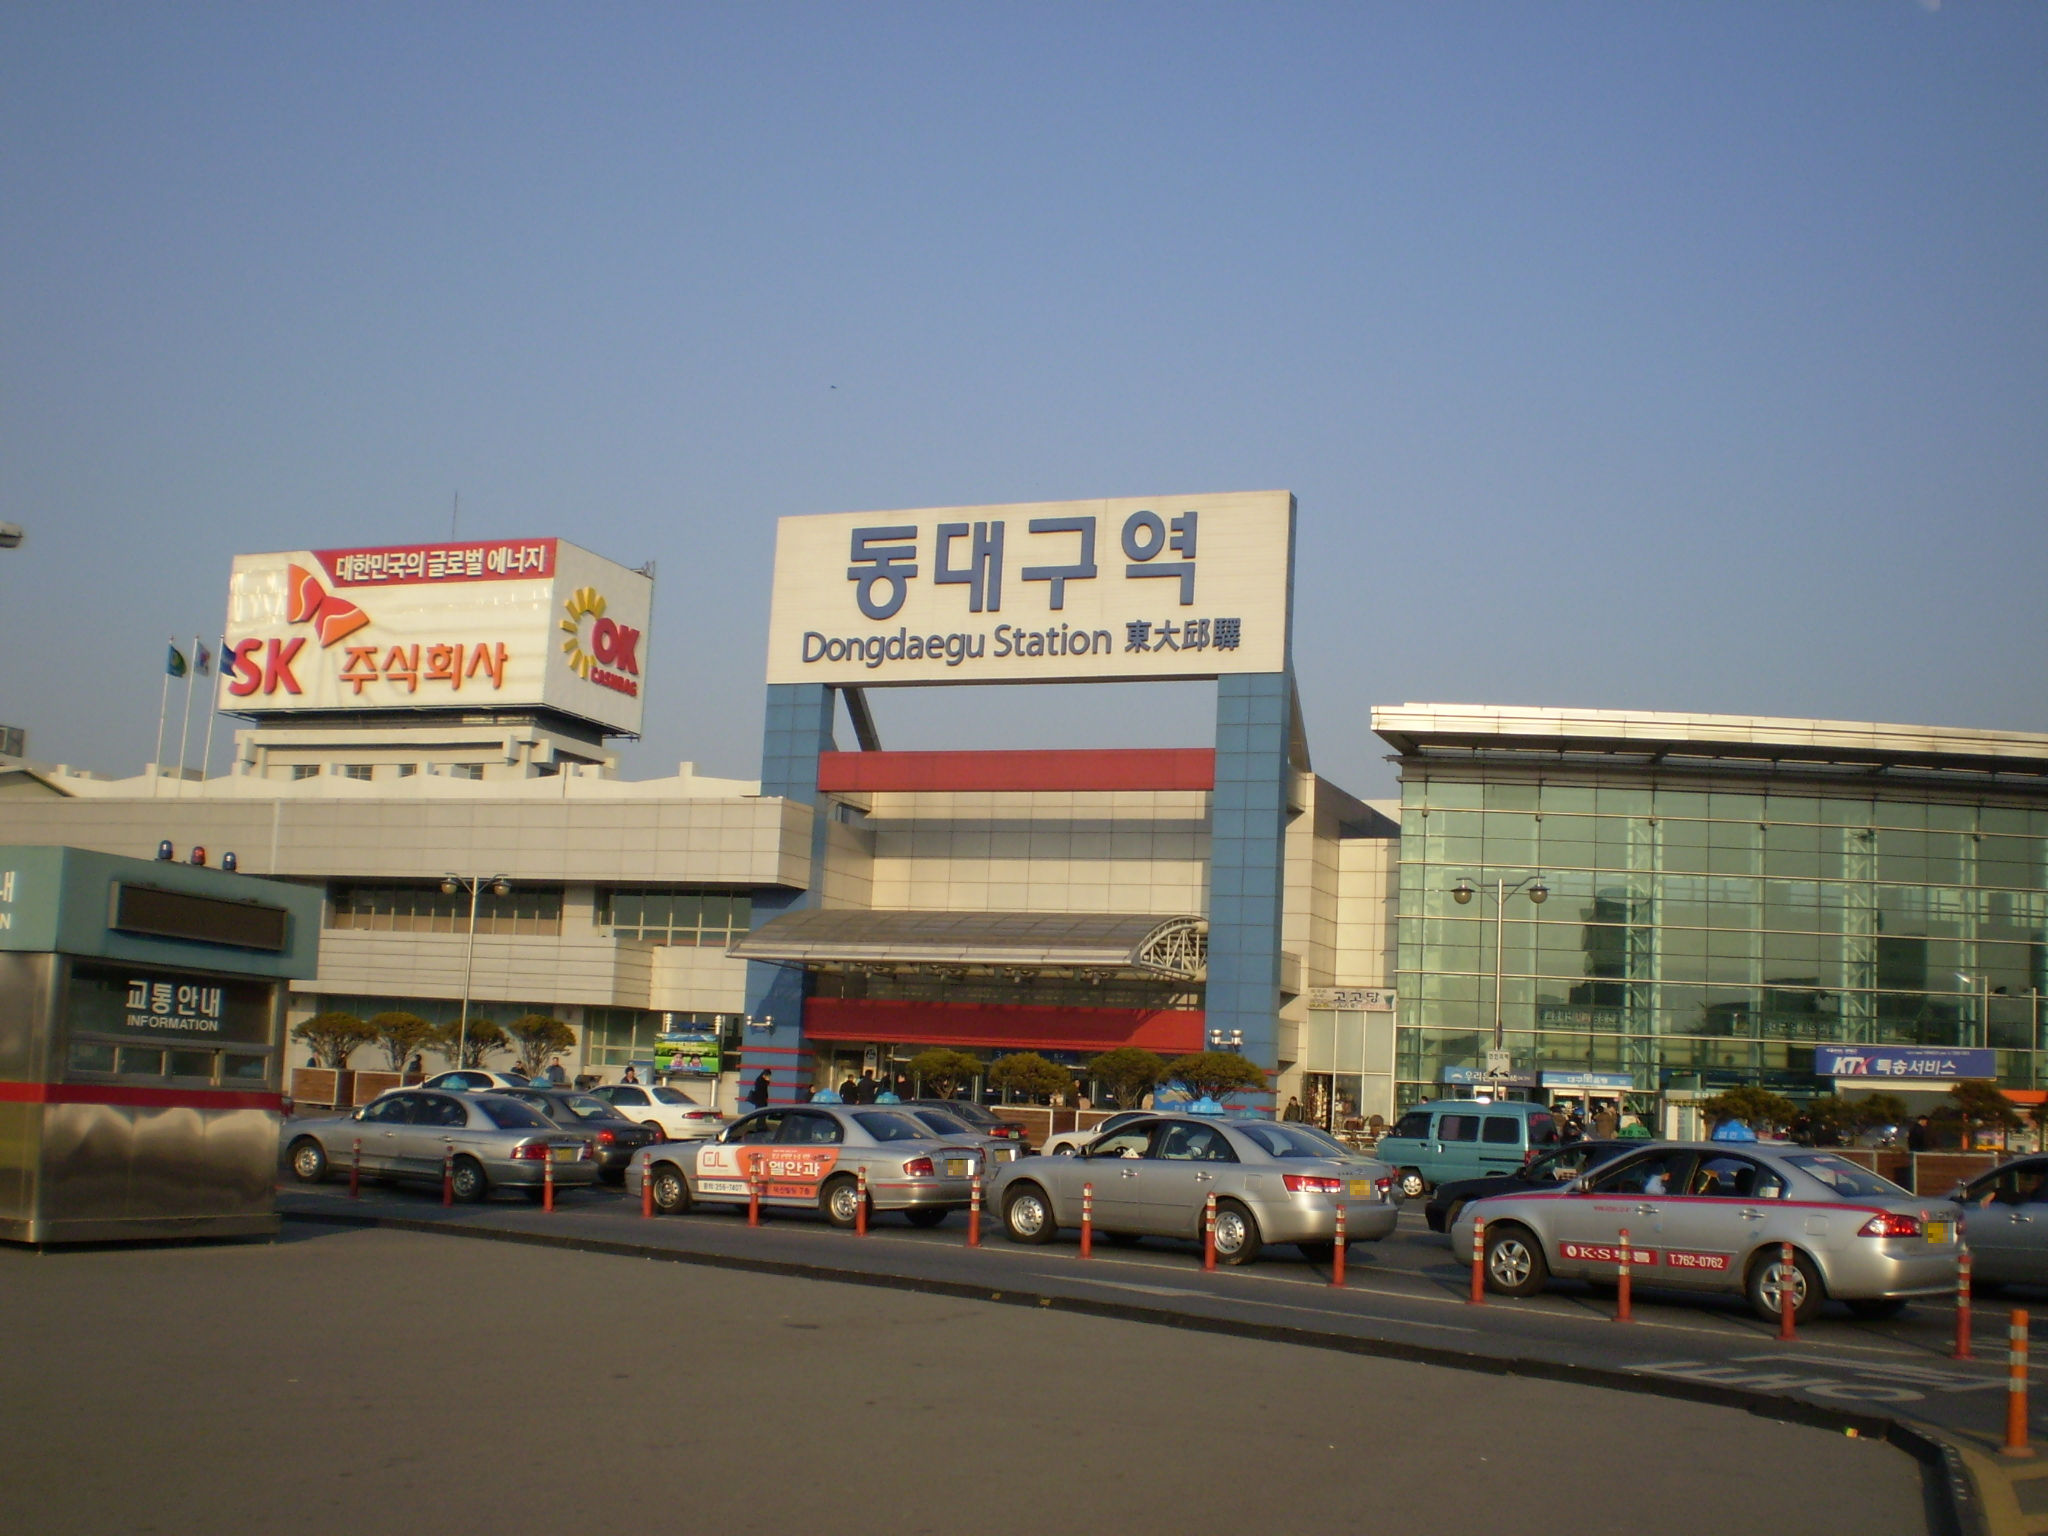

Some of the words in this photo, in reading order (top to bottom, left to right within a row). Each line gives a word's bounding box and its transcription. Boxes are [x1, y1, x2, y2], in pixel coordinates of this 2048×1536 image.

[335, 551, 425, 582] 대한민국의
[427, 549, 483, 579] 글로벌
[487, 545, 546, 575] 에너지
[847, 510, 1198, 621] 동대구역
[591, 616, 640, 676] OK
[801, 626, 986, 669] Dongdaegu
[993, 623, 1112, 658] Station
[1124, 617, 1242, 654] 東大邱驛
[229, 636, 307, 696] SK
[339, 641, 509, 695] 주식회사
[125, 980, 222, 1018] 교통안내
[127, 1014, 219, 1032] INFORMATION
[1831, 1056, 1874, 1075] KTX
[1670, 1254, 1724, 1269] T.762-0762
